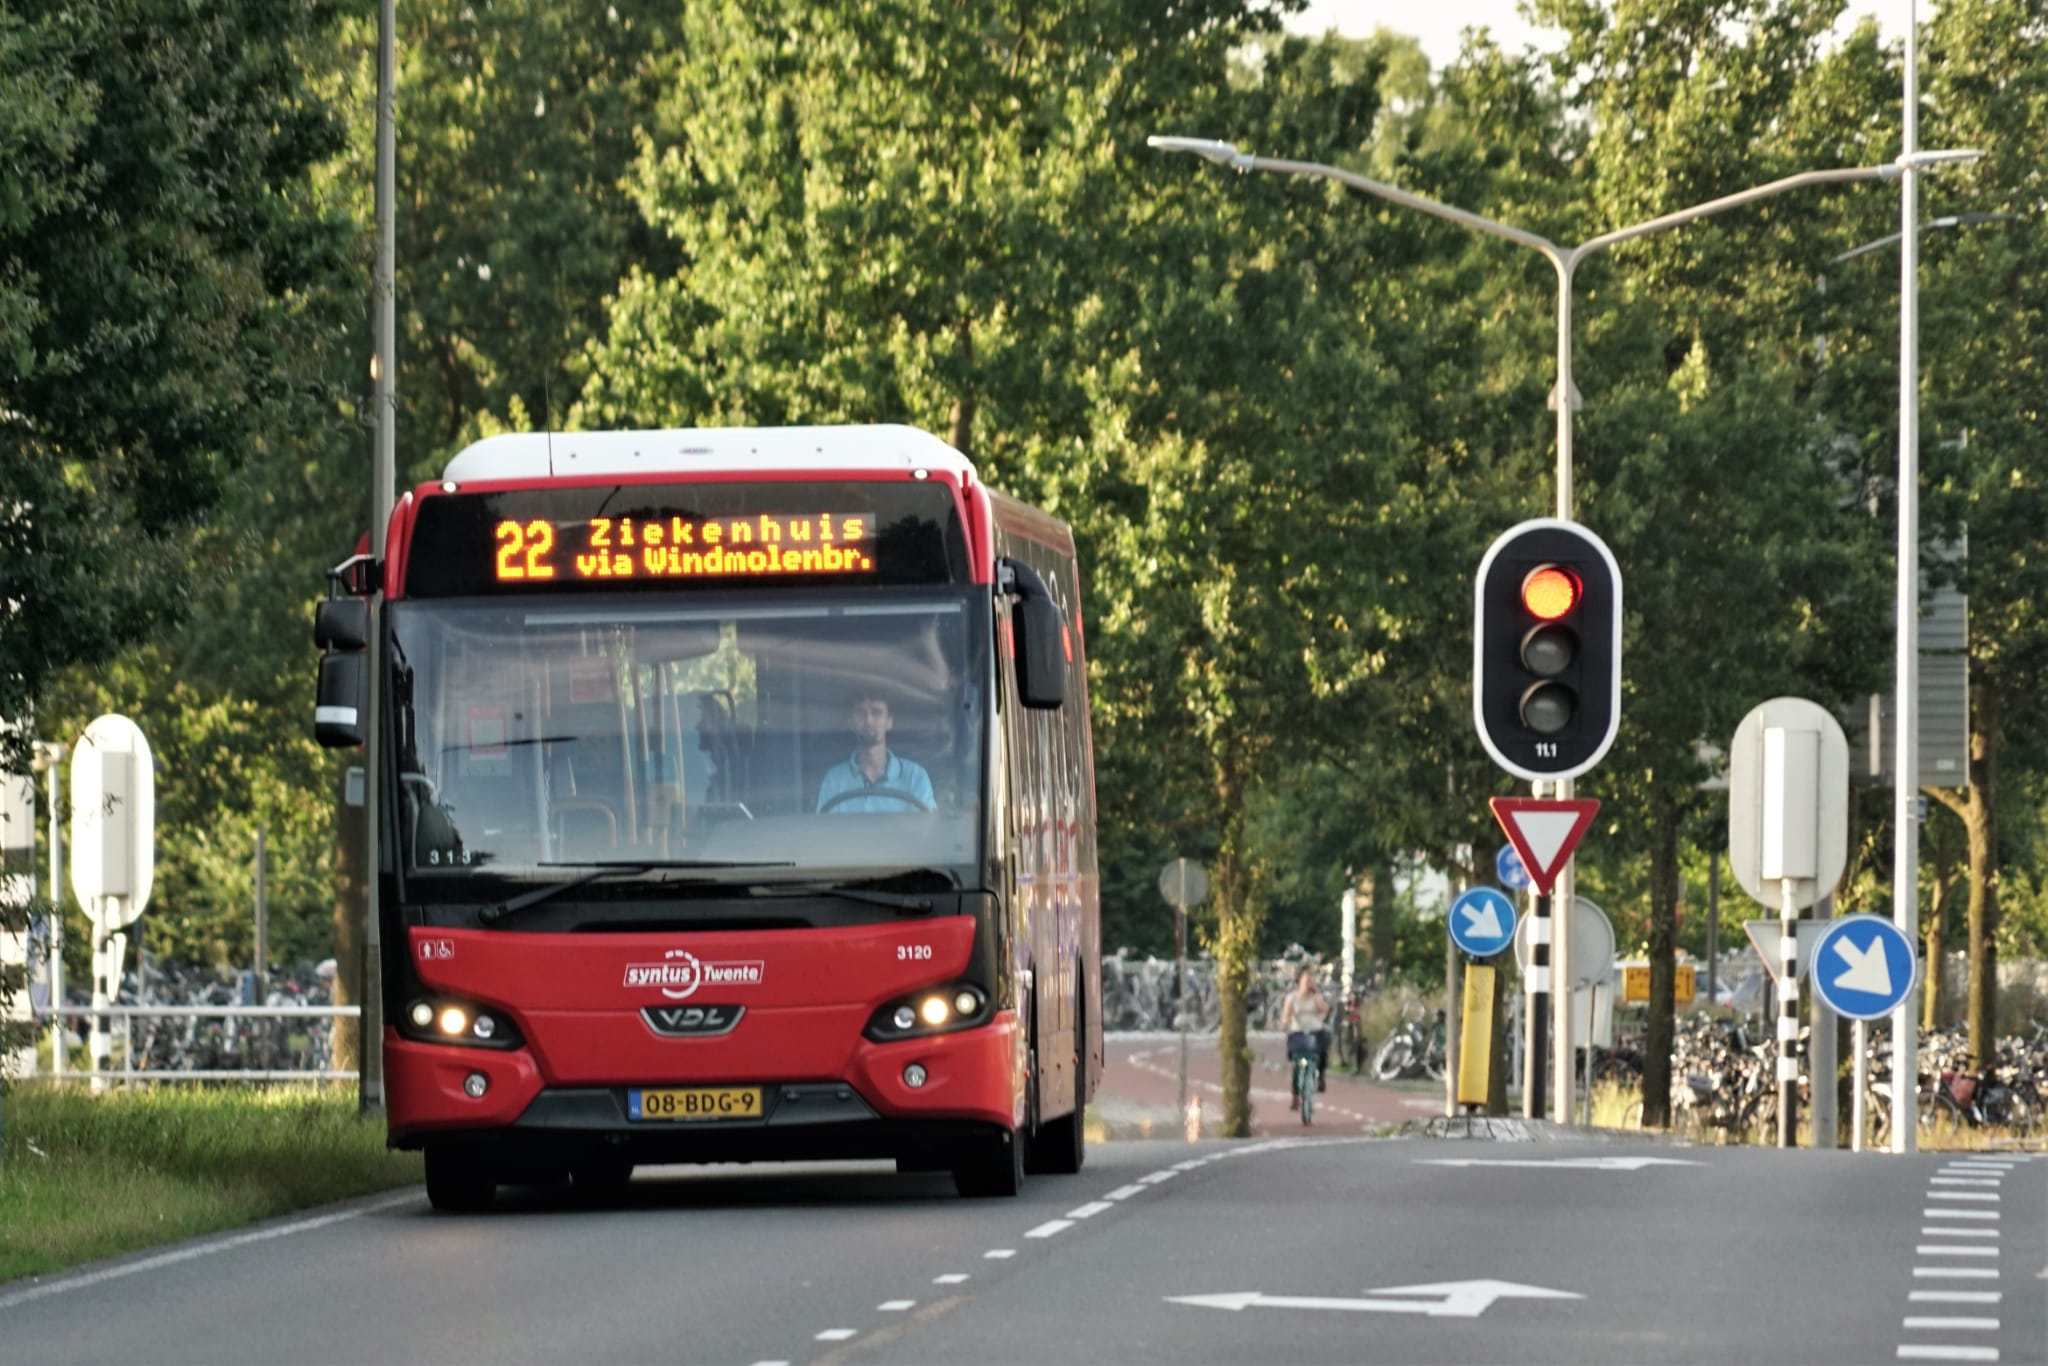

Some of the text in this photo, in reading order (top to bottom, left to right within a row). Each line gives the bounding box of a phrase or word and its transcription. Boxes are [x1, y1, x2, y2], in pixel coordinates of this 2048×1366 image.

[590, 513, 864, 546] Ziekenhuis
[496, 519, 553, 578] 22
[577, 543, 871, 577] via Windmolenbr.
[1535, 742, 1557, 758] 11.1
[897, 945, 932, 960] 3120
[628, 964, 759, 984] syntus Twente
[658, 1008, 725, 1026] VDL
[646, 1092, 755, 1114] 08-BDG-9
